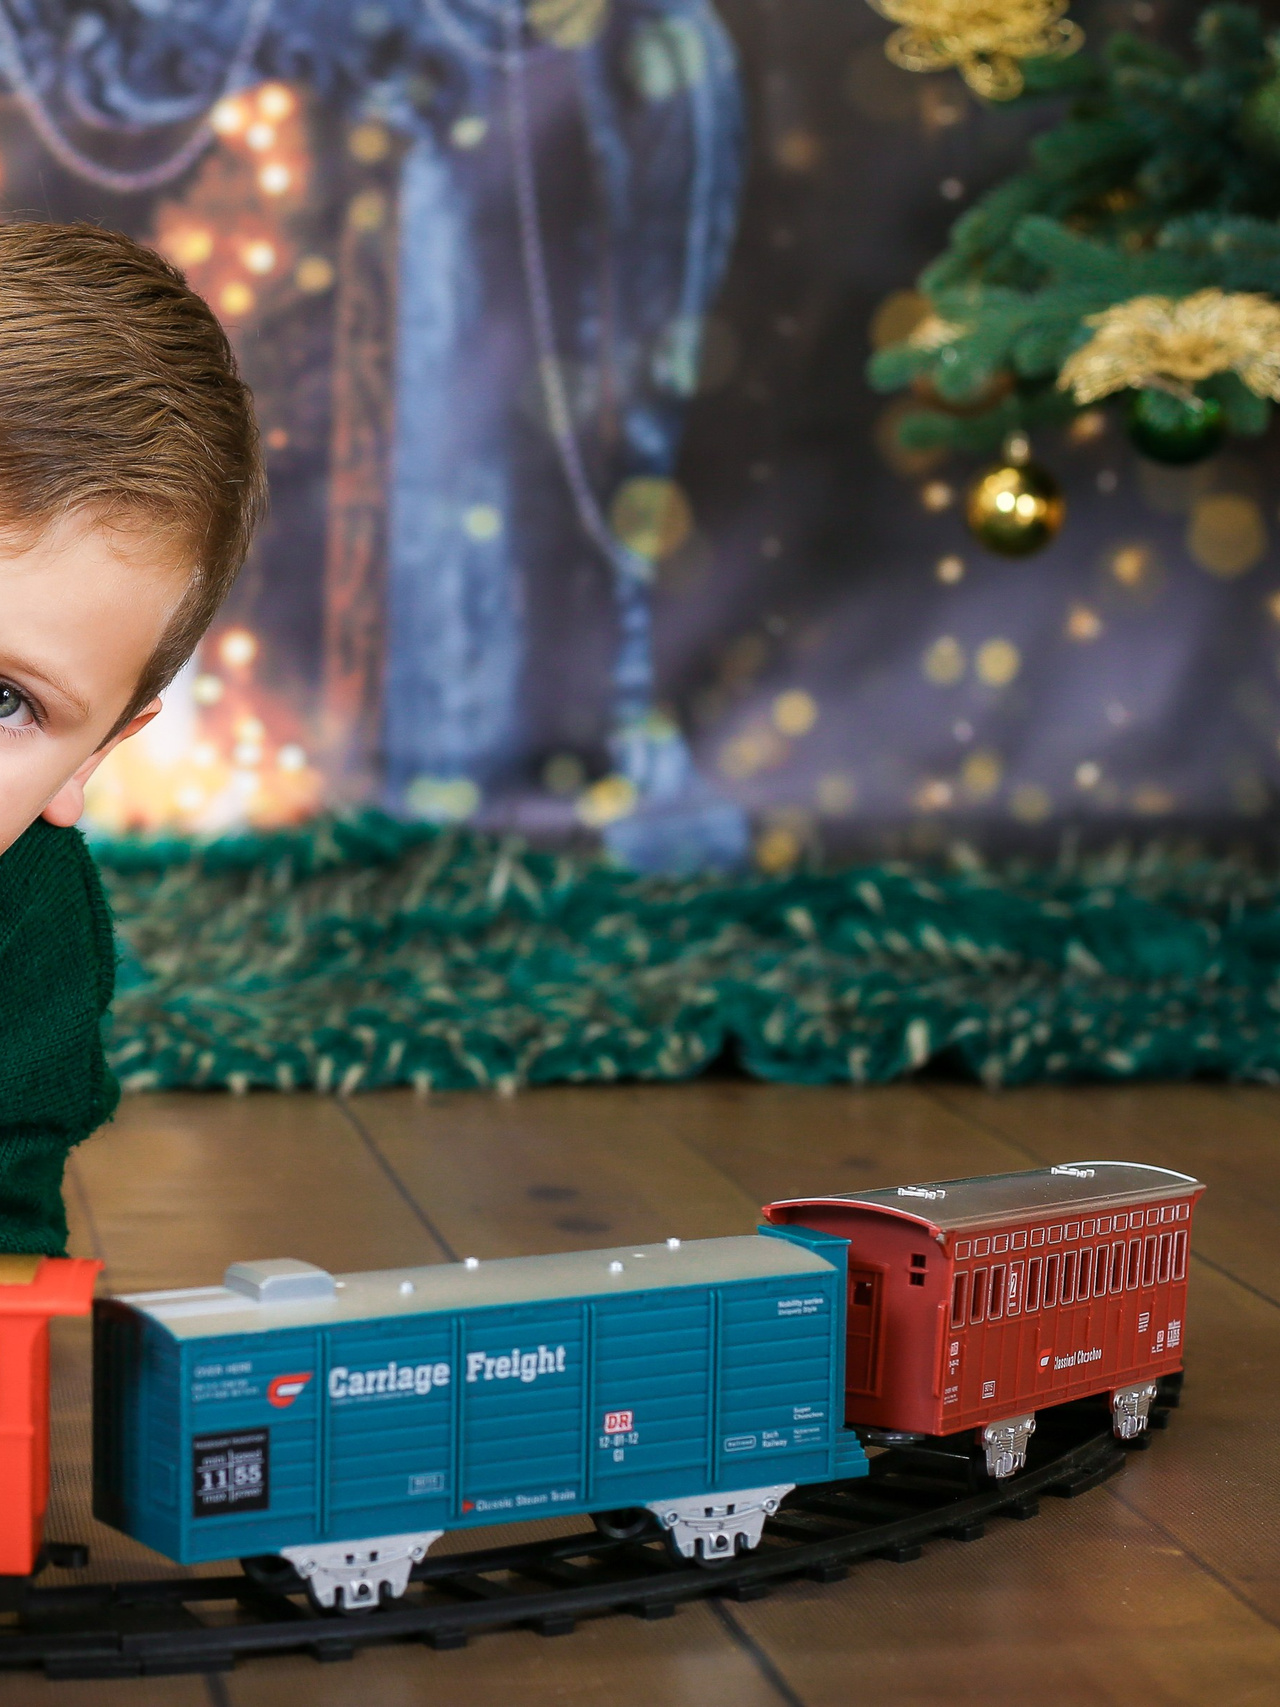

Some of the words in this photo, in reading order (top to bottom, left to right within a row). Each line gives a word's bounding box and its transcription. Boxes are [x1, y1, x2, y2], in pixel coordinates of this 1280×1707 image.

[328, 1361, 451, 1398] Carriage
[466, 1345, 566, 1383] Freight
[607, 1414, 629, 1429] DR
